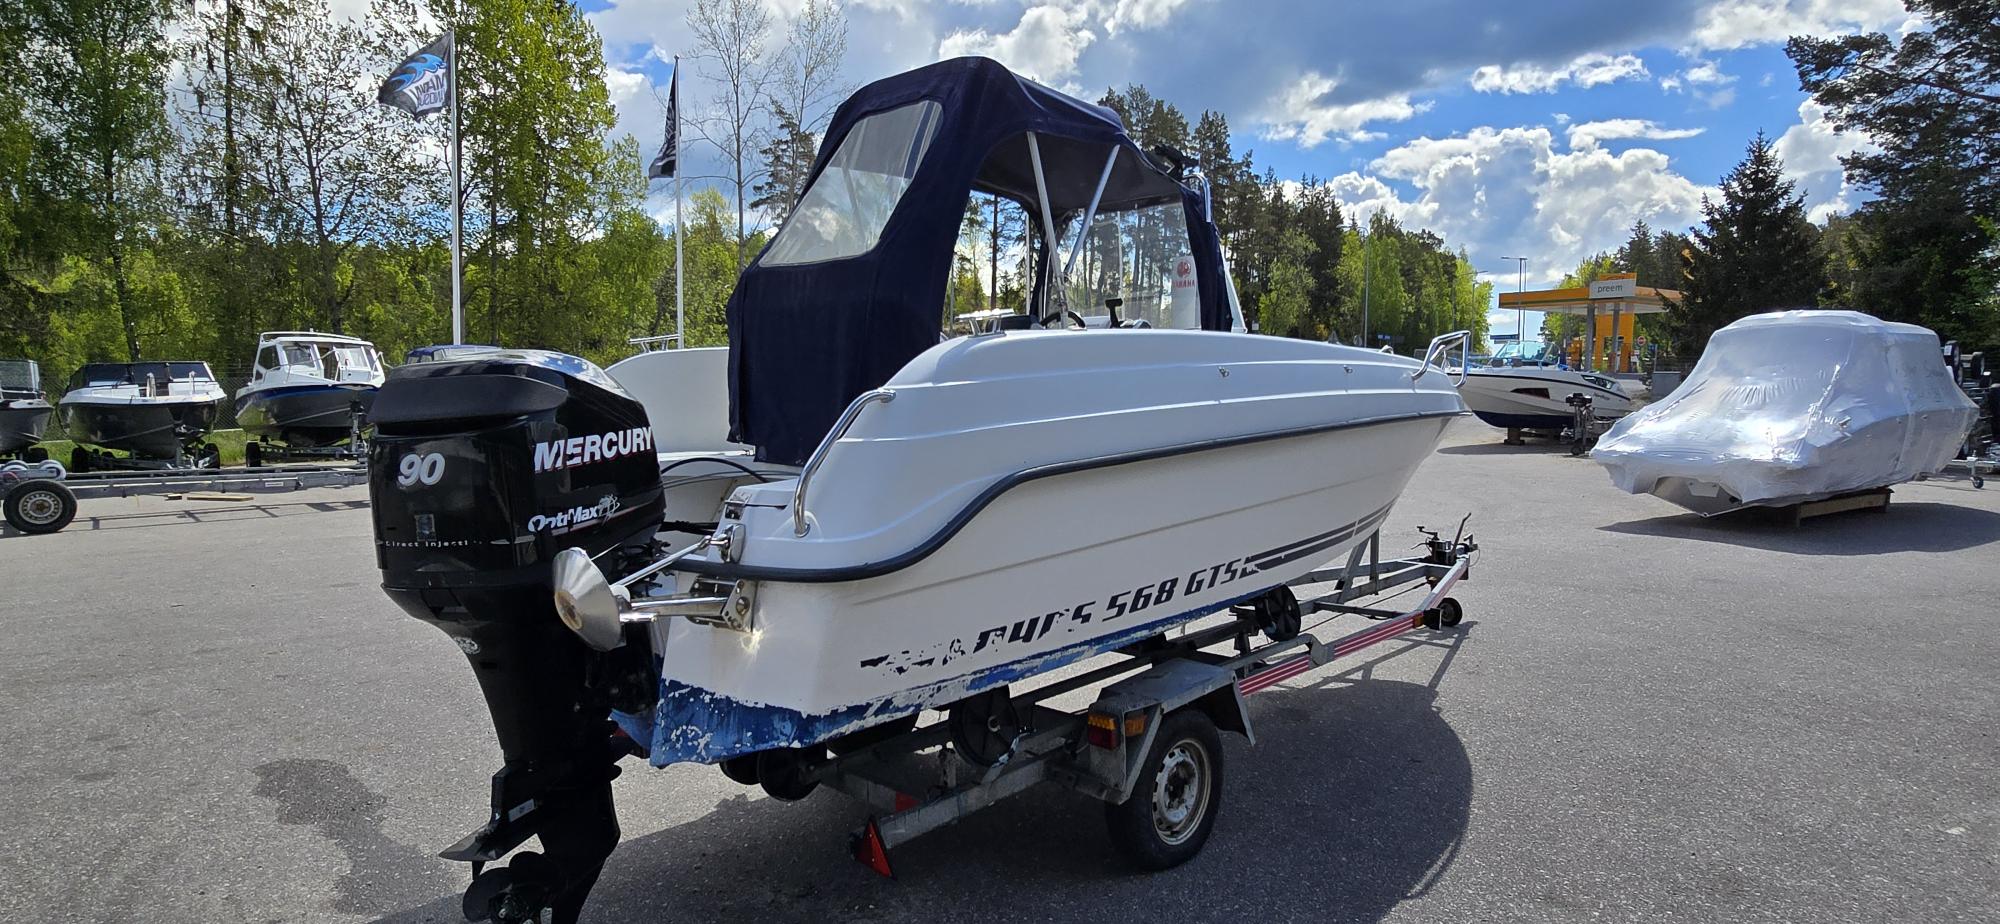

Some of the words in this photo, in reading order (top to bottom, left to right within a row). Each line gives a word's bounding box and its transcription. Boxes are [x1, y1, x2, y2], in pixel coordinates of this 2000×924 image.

[1597, 285, 1623, 294] preem
[533, 427, 652, 474] MERCURY
[398, 452, 446, 487] 90
[527, 506, 599, 533] OptiMax
[1101, 576, 1179, 623] 568
[1183, 558, 1242, 597] GTS
